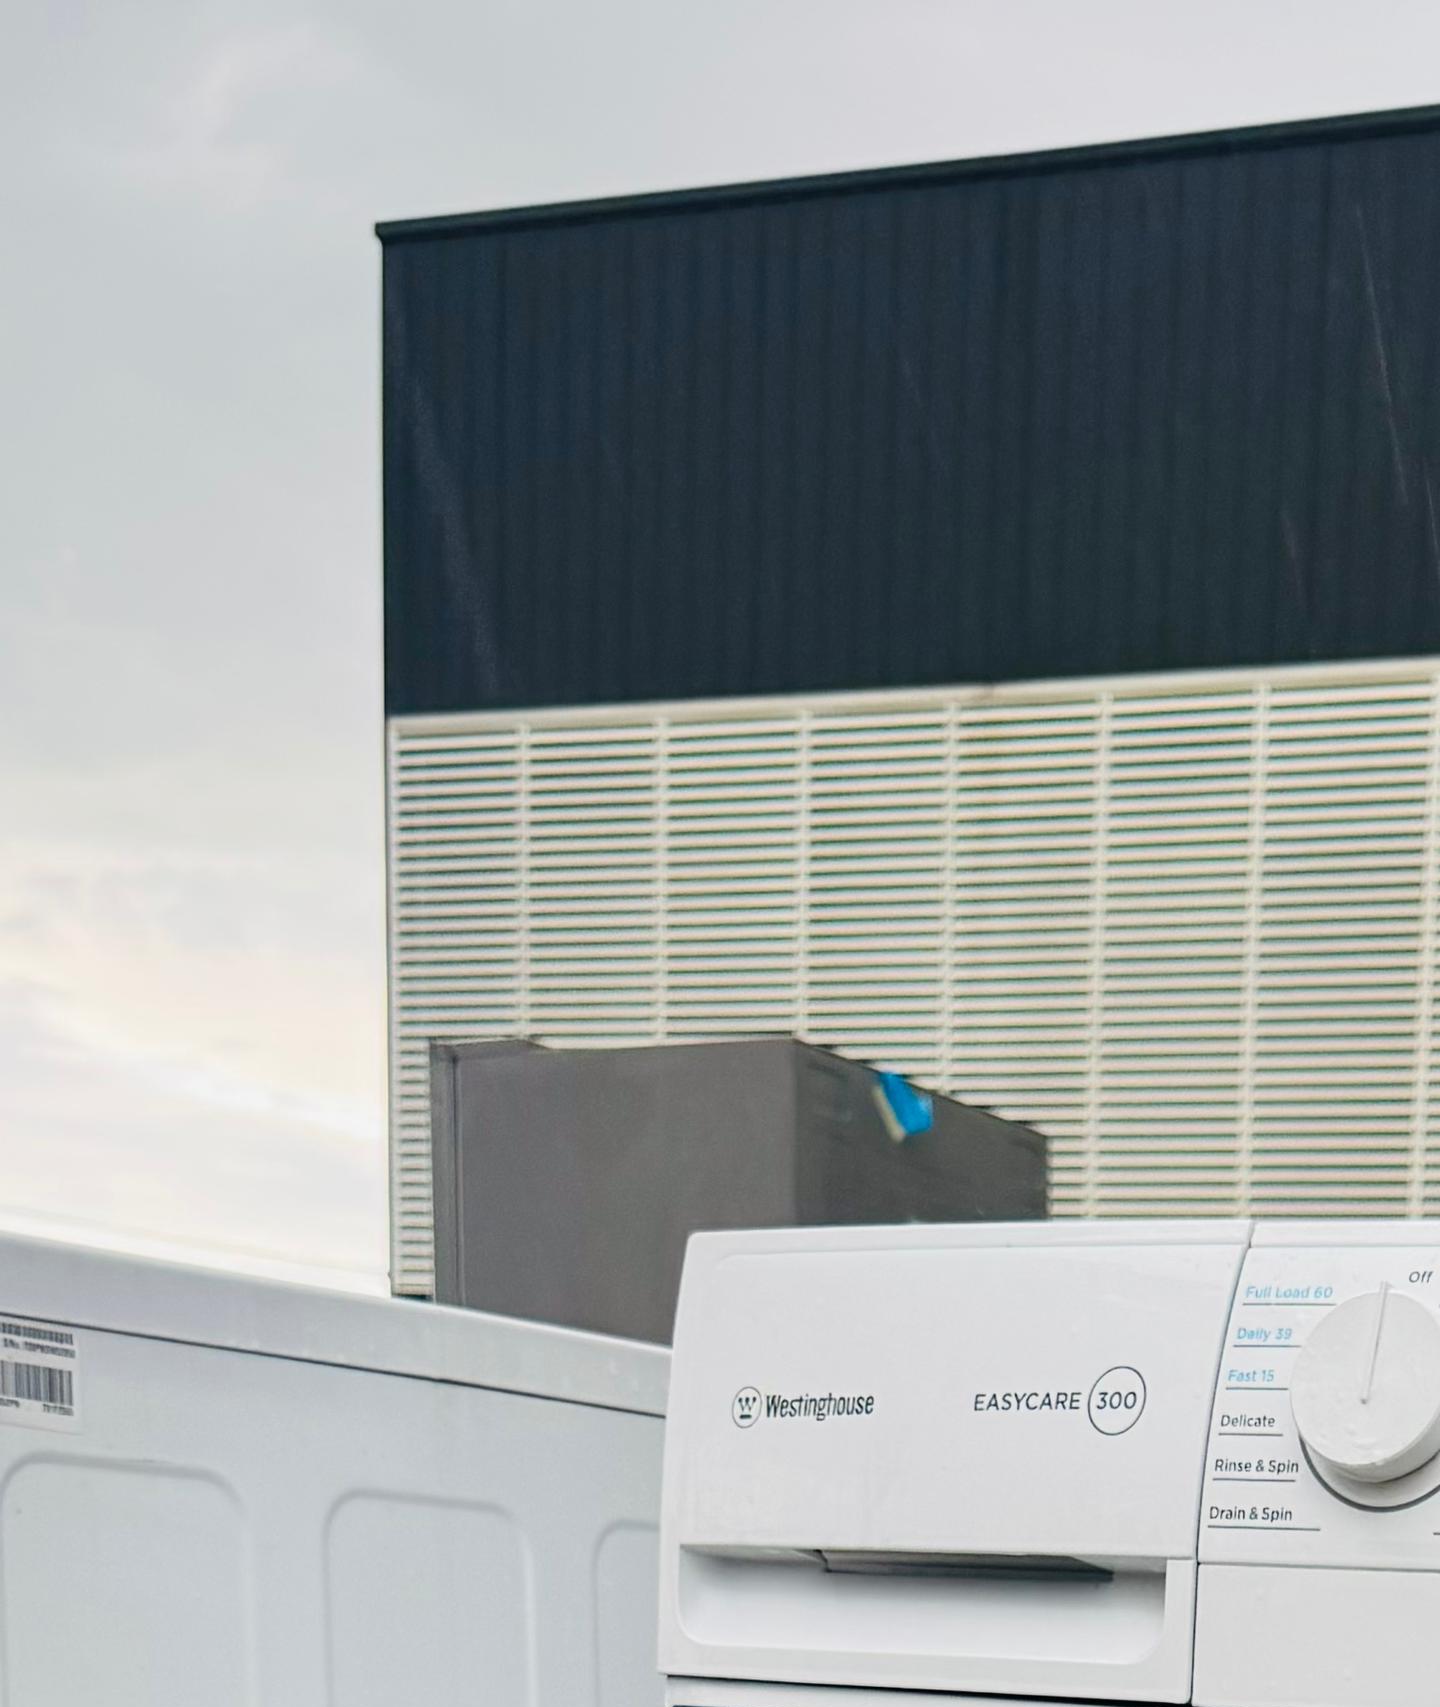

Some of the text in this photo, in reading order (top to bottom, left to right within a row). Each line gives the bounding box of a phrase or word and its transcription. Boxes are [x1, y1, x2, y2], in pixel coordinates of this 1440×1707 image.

[1408, 1270, 1434, 1285] Off
[1246, 1286, 1334, 1299] Full Load 60
[1236, 1327, 1293, 1343] Daily 39
[1228, 1369, 1275, 1383] Fast 15
[765, 1393, 874, 1421] Westinghouse
[973, 1391, 1138, 1411] EASYCARE 300
[1220, 1413, 1276, 1428] Delicate
[1214, 1458, 1299, 1477] Rinse & Spin
[1209, 1505, 1293, 1525] Drain & Spin
